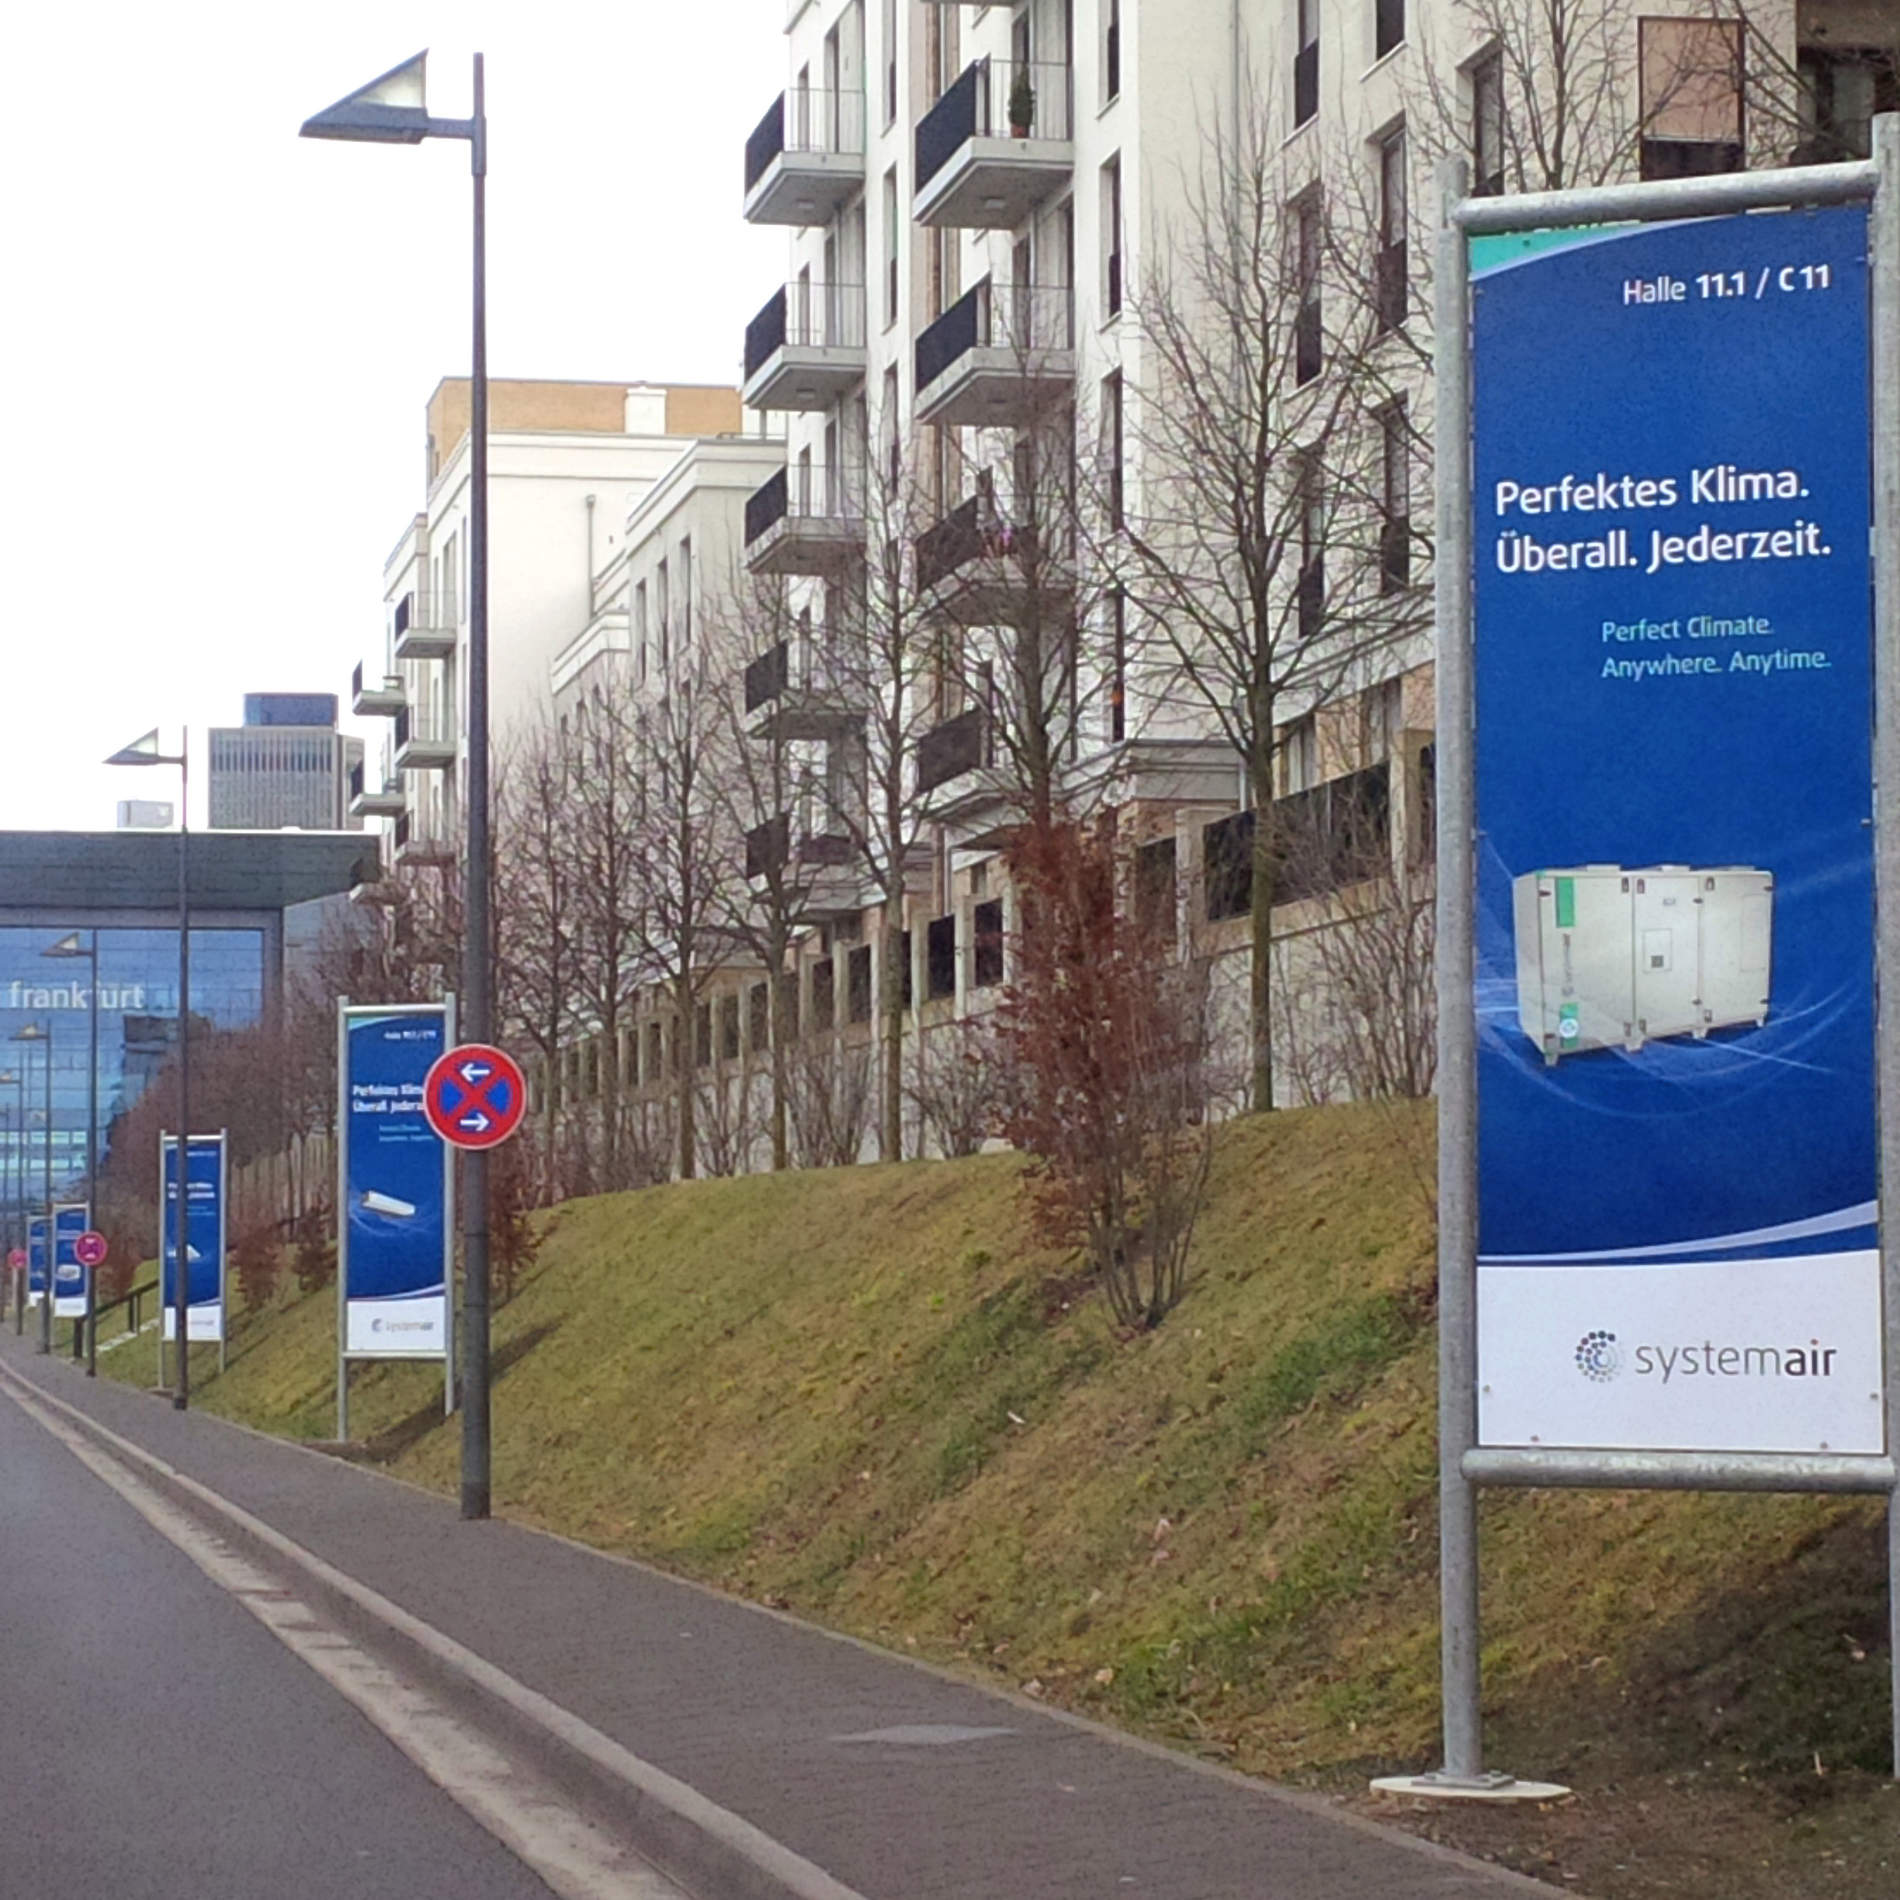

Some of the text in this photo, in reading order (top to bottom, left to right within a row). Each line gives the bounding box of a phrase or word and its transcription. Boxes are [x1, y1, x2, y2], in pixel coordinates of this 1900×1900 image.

[1623, 275, 1687, 304] Halle
[1696, 271, 1745, 298] 11.1
[1496, 465, 1810, 515] Perfektes Klima.
[1496, 520, 1832, 573] Überall. Jederzeit.
[1602, 617, 1680, 642] Perfect
[1602, 648, 1832, 682] Anywhere. Anytime.
[9, 980, 145, 1009] frankurt
[1635, 1338, 1837, 1384] systemair
